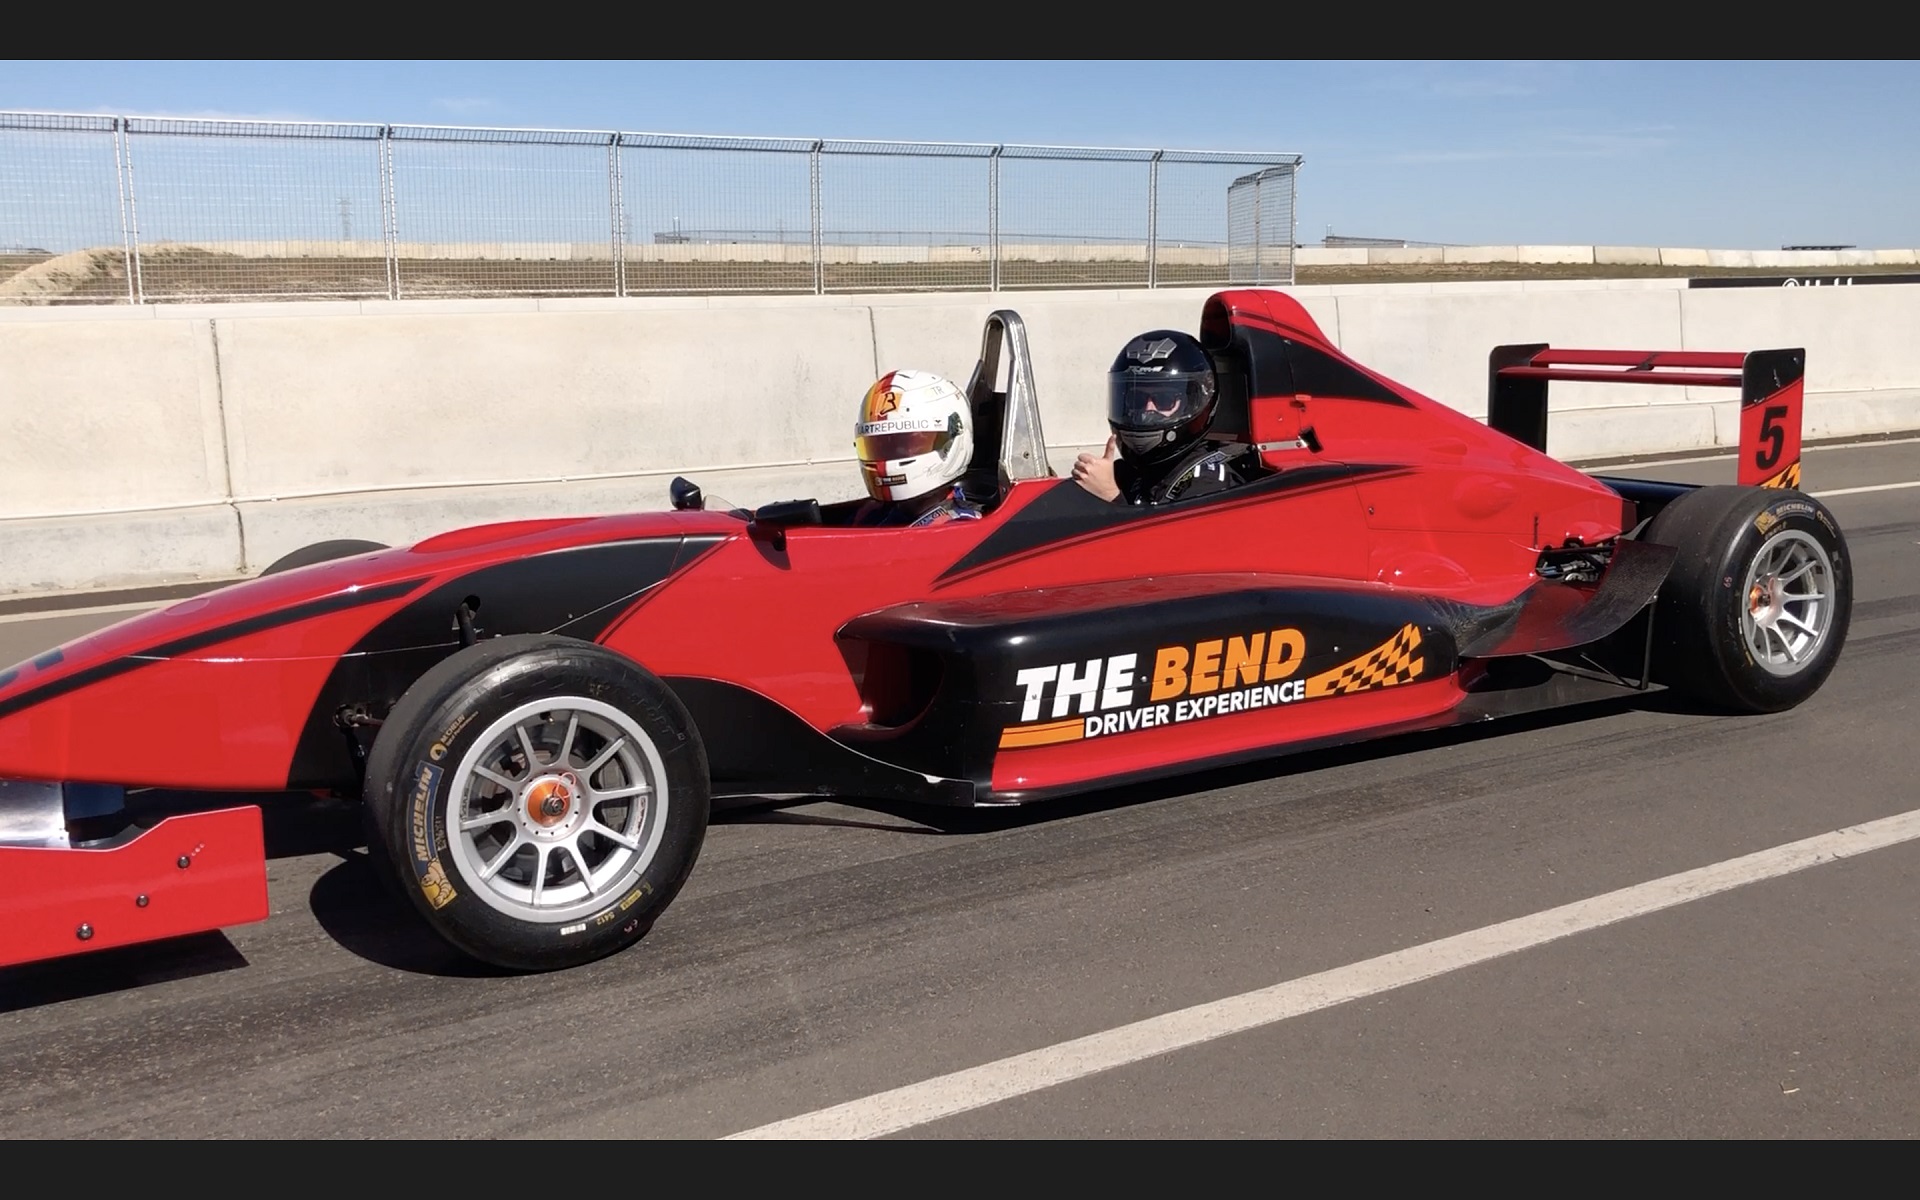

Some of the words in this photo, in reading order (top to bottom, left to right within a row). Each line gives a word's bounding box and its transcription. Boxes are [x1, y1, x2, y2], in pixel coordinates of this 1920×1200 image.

[1756, 406, 1788, 470] 5
[1776, 503, 1814, 515] MICHELIN
[1016, 653, 1137, 721] THE
[1150, 628, 1306, 701] BEND
[1085, 704, 1169, 738] DRIVER
[1175, 679, 1305, 718] EXPERIENCE
[413, 767, 433, 861] MICHELIN
